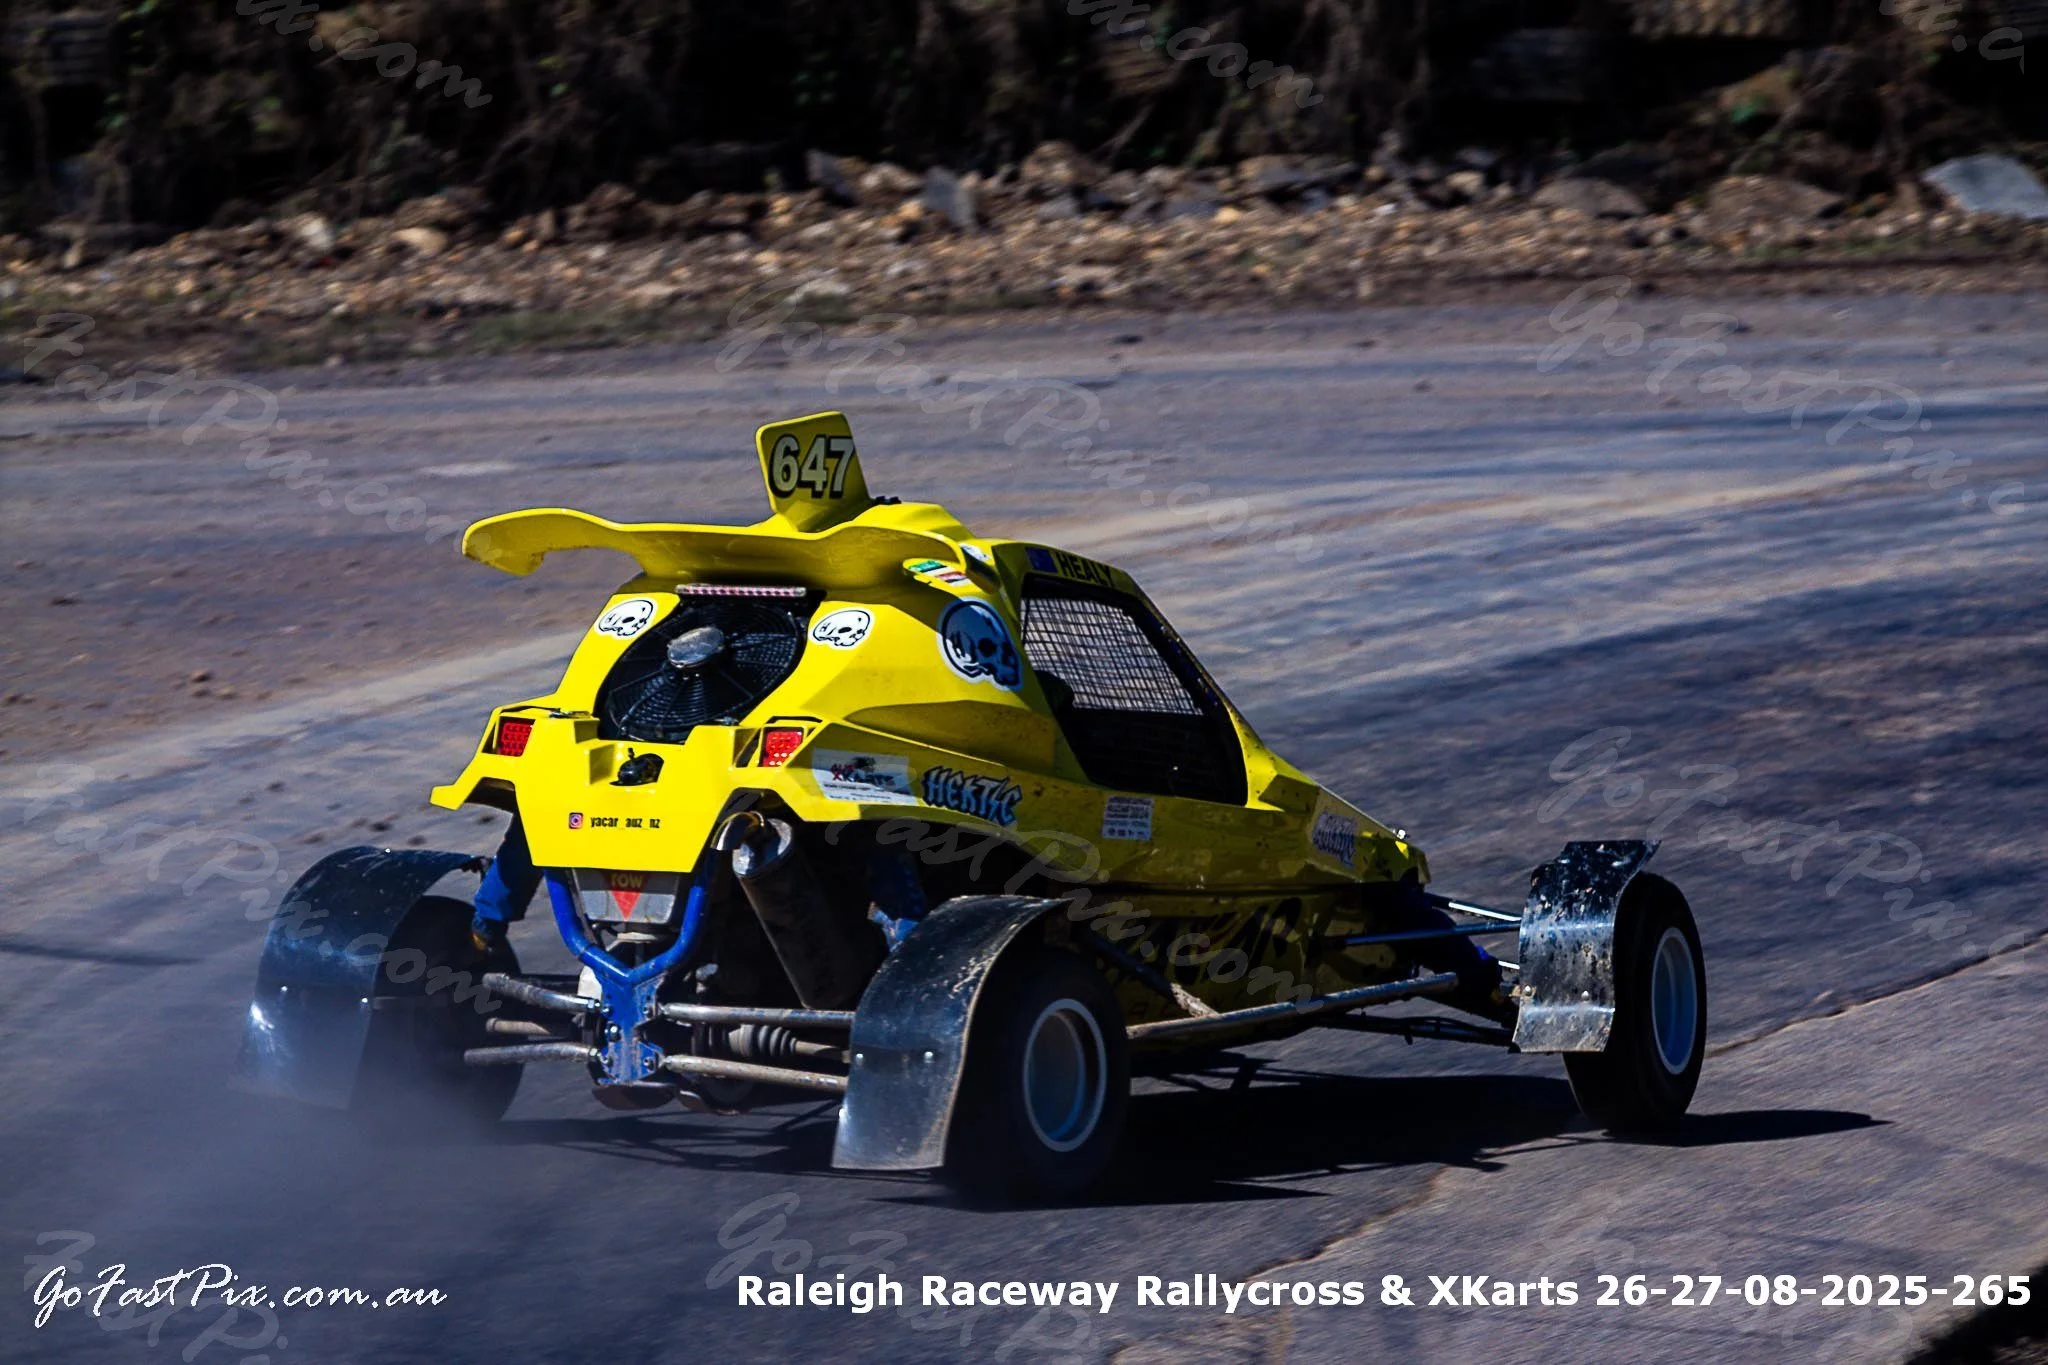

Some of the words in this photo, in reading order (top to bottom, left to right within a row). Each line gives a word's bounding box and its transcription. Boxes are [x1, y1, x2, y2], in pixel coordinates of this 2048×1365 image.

[769, 433, 855, 499] 647
[1054, 551, 1115, 588] HEALY
[922, 765, 1023, 826] HEKTIC
